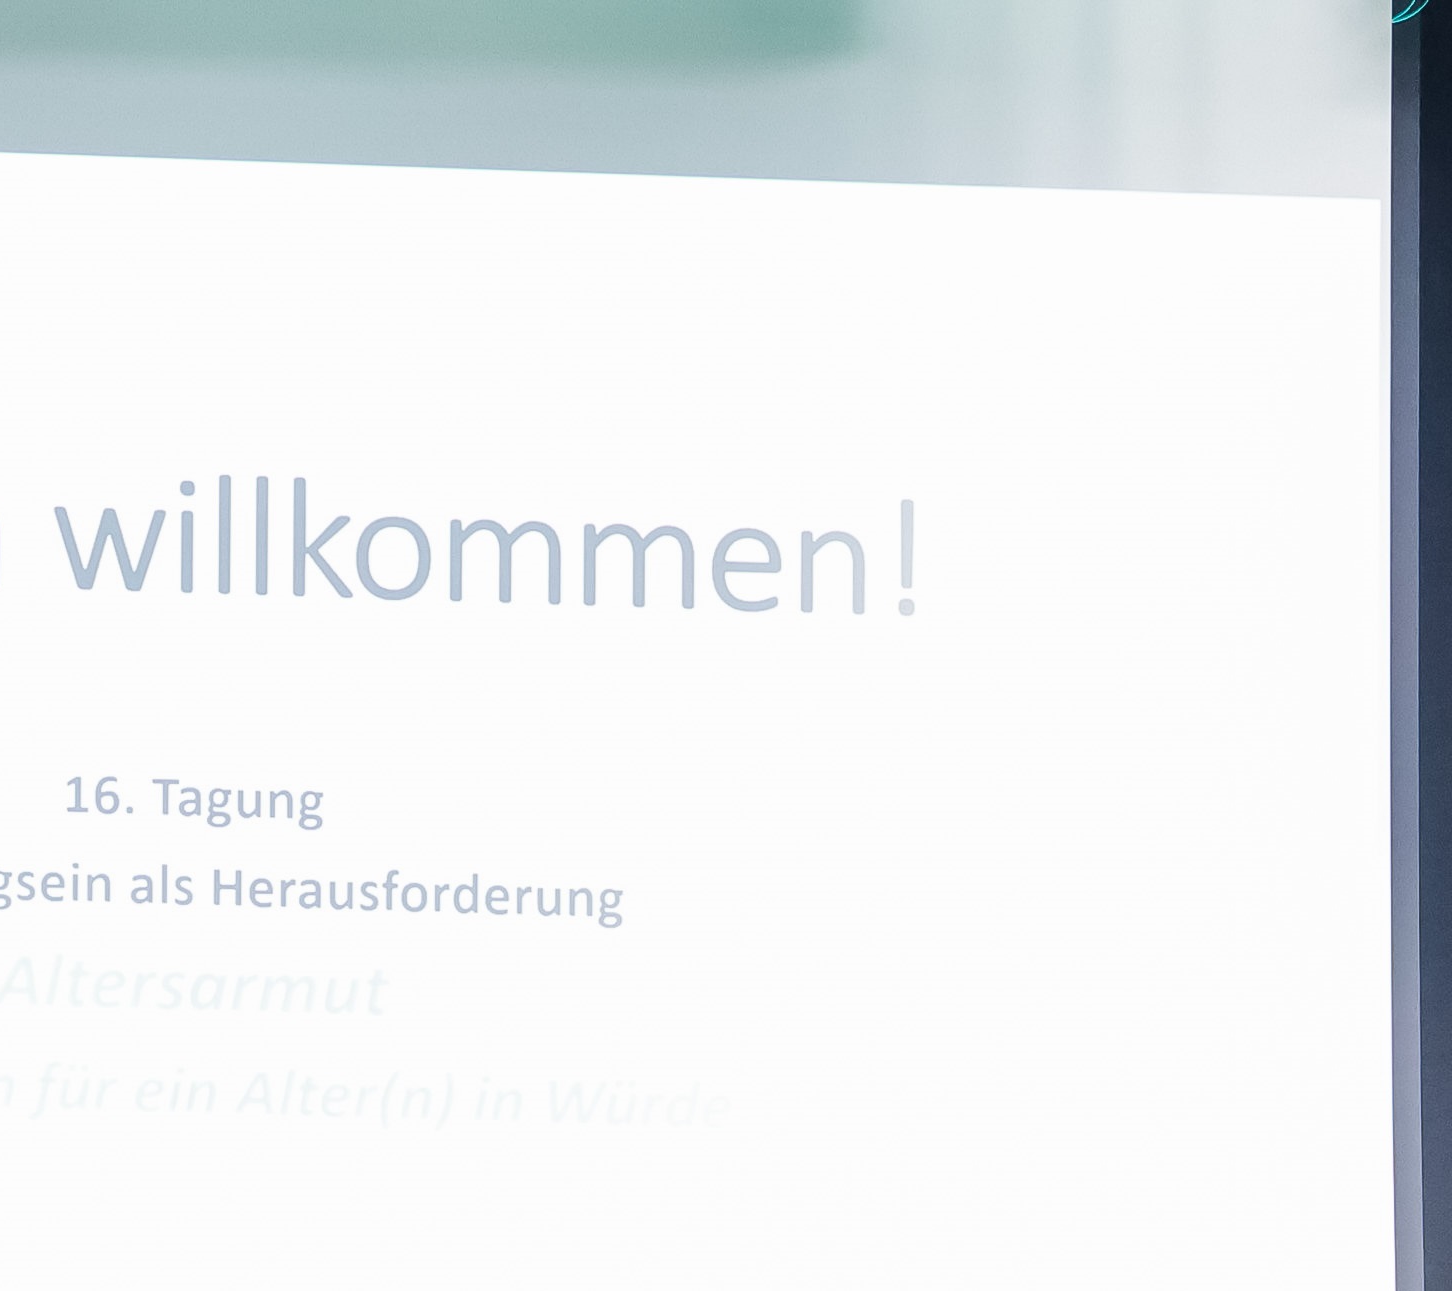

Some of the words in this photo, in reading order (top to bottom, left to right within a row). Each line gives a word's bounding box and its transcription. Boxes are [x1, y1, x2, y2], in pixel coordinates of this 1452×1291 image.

[53, 474, 915, 616] willkommen!
[67, 776, 133, 815] 16.
[152, 779, 324, 831] Tagung
[130, 864, 194, 906] als
[213, 869, 623, 928] Herausforderung
[28, 1060, 118, 1121] für
[134, 1066, 218, 1113] ein
[235, 1069, 455, 1131] Alter(n)
[473, 1075, 524, 1121] in
